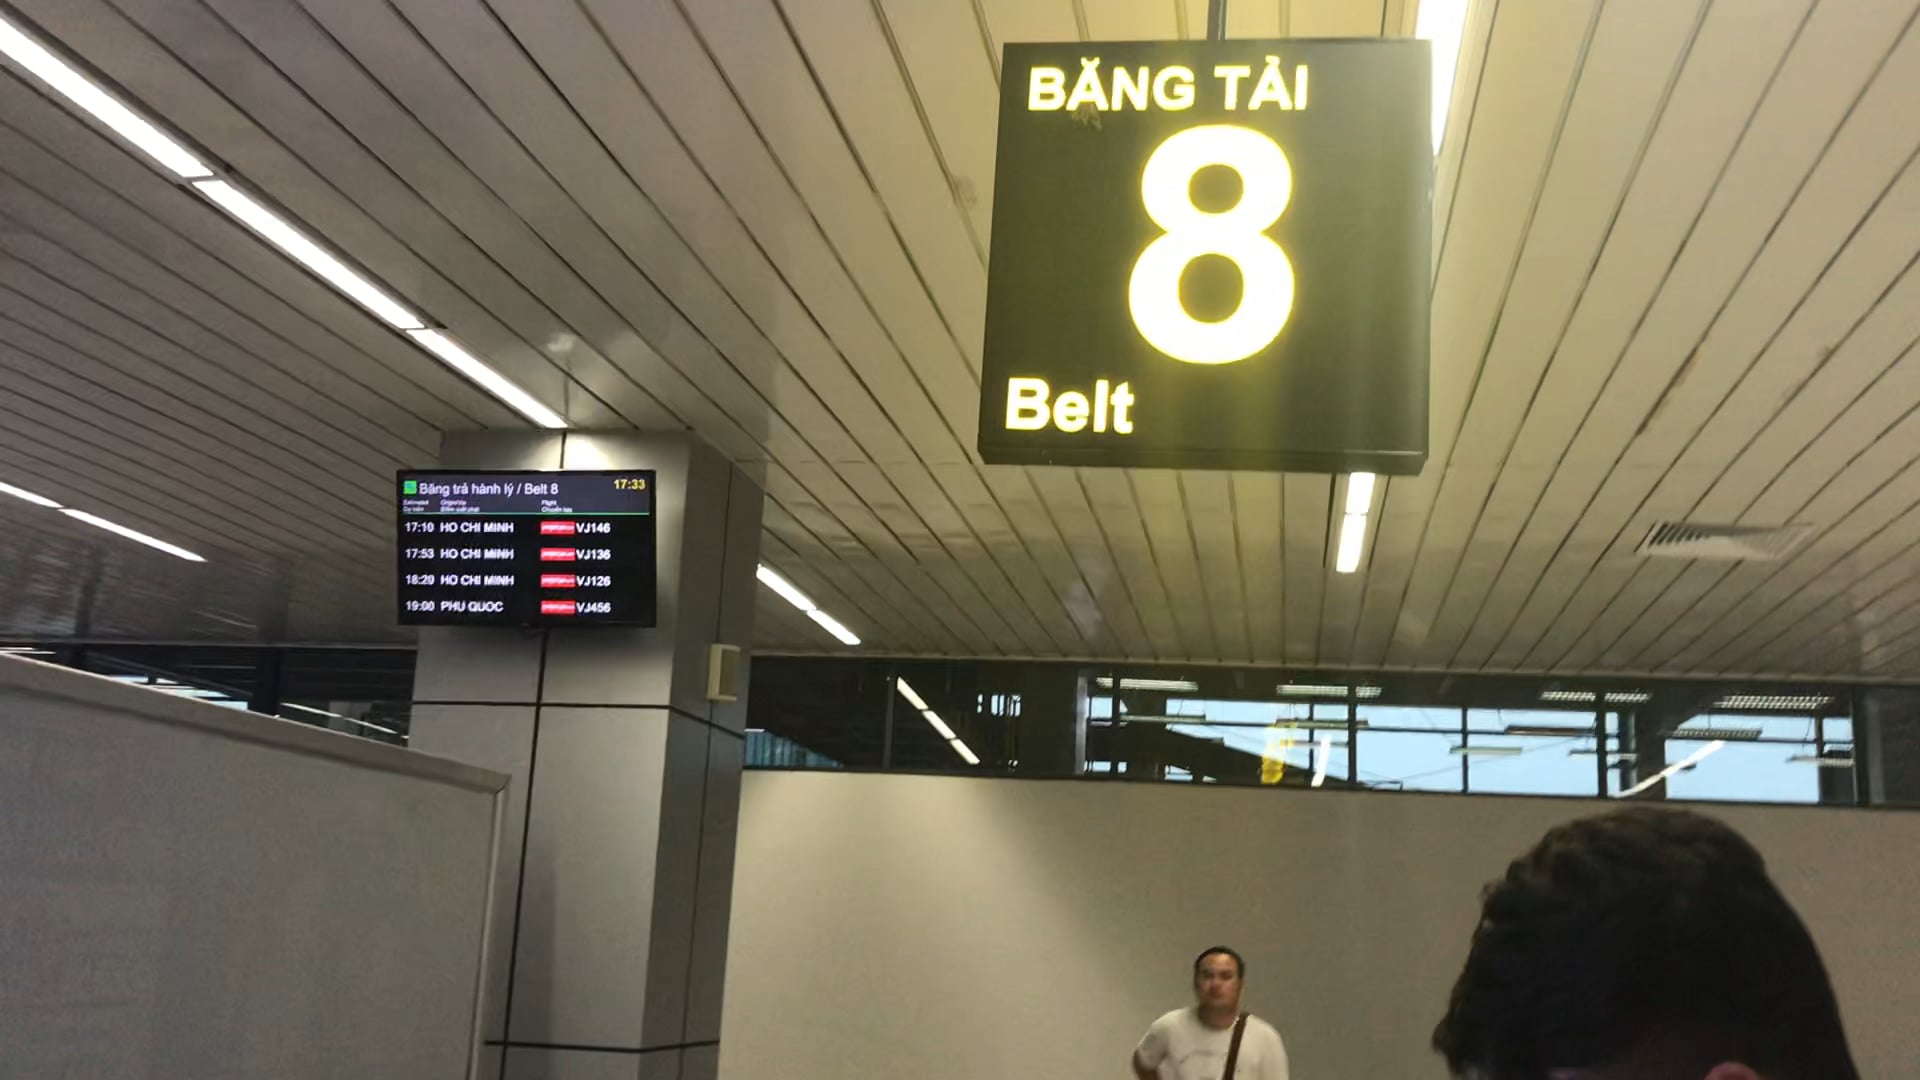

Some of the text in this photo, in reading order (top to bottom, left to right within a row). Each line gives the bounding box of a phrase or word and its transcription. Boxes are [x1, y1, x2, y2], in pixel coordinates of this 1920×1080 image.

[1028, 55, 1309, 112] BĂNG TẢI
[1128, 124, 1295, 365] 8
[1005, 377, 1134, 434] Belt
[471, 483, 501, 495] hành
[524, 483, 548, 495] Belt
[550, 483, 559, 495] 8
[613, 479, 646, 490] 17:33
[405, 522, 435, 532] 17:10
[440, 522, 514, 532] HO CHI MINH
[576, 522, 611, 533] VJ146
[405, 548, 435, 559] 17:53
[440, 548, 514, 559] HO CHI MINH
[576, 548, 611, 560] VJ136
[440, 575, 514, 586] HO CHI MINH
[440, 601, 504, 612] PHU QUOC
[576, 601, 611, 613] VJ456
